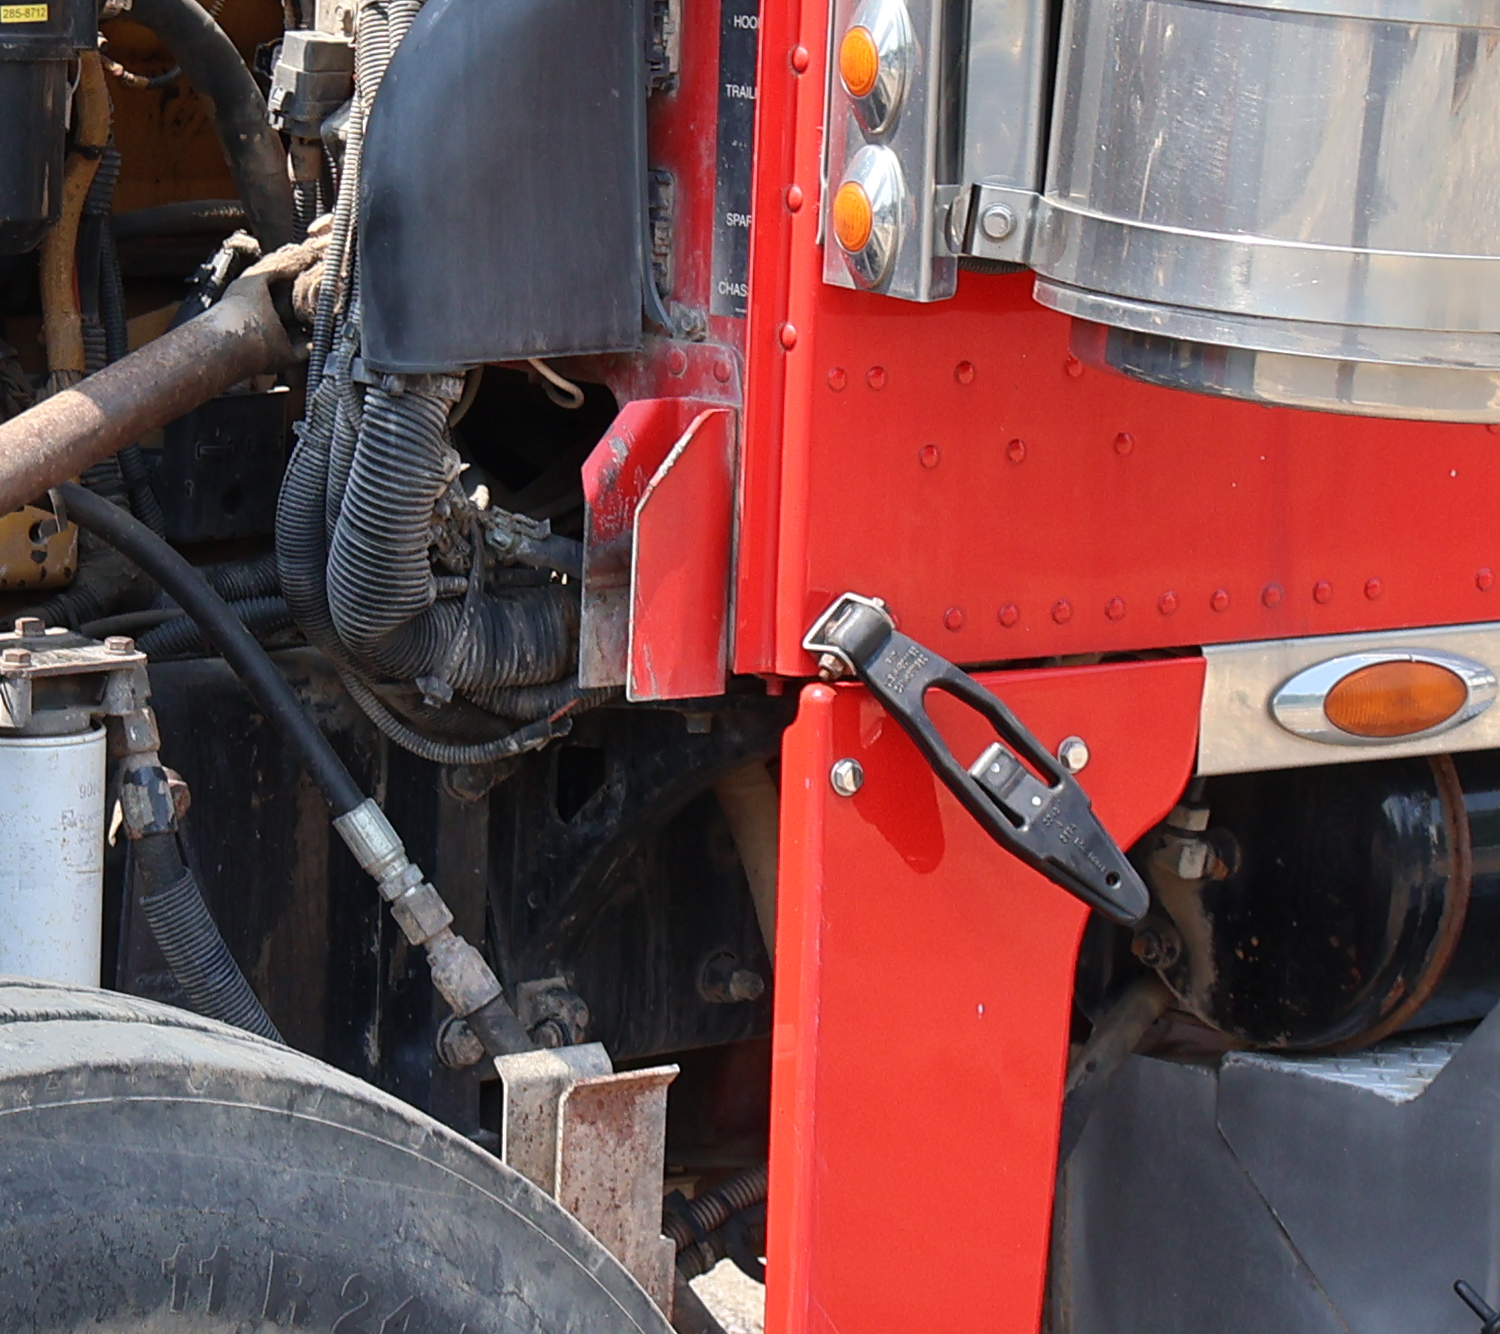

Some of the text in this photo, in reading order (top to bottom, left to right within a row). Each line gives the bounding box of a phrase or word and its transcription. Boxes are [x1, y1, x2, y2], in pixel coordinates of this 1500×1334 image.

[2, 8, 46, 19] 285-8712
[733, 15, 760, 29] HOO
[718, 281, 748, 297] CHAS
